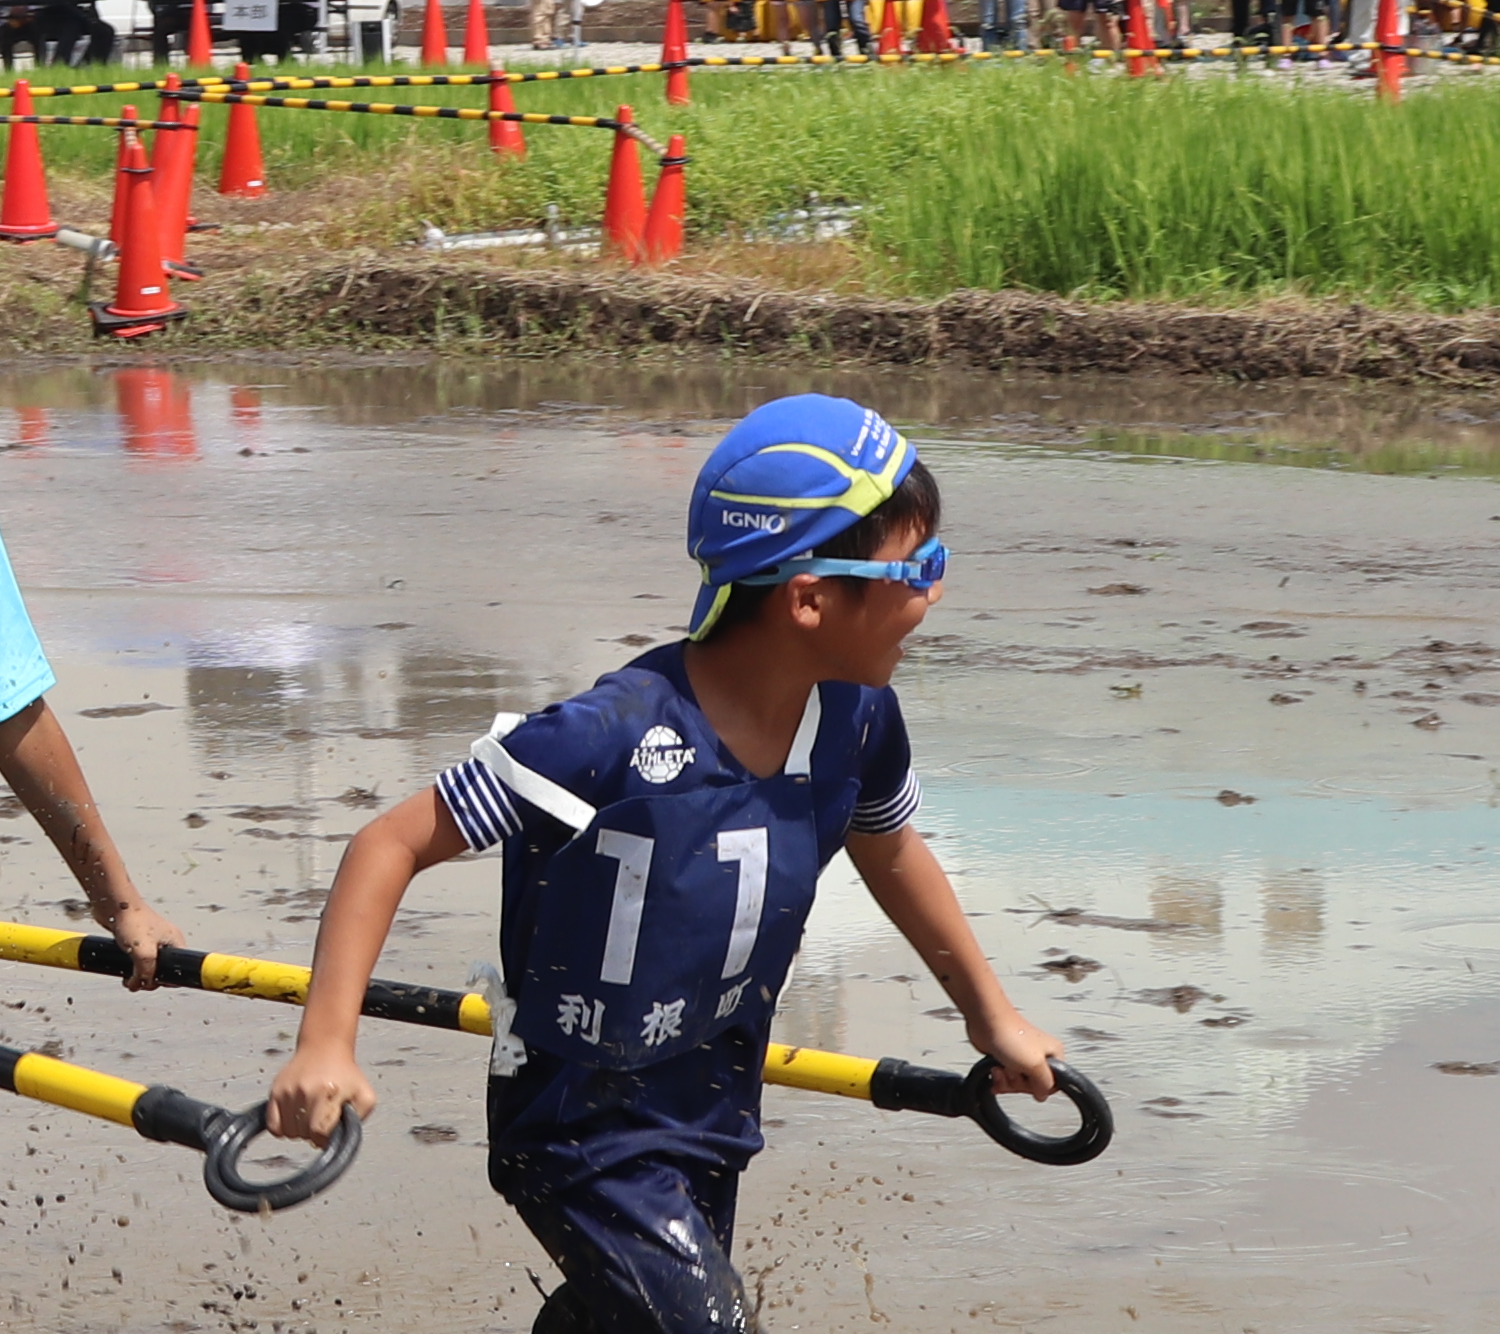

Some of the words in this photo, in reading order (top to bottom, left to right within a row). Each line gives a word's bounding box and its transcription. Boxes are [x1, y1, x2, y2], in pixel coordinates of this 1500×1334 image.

[231, 3, 270, 21] 本部
[721, 509, 786, 535] IGNIO
[629, 747, 696, 768] ATHLETA
[595, 826, 769, 987] 11
[556, 977, 753, 1046] 利根町
